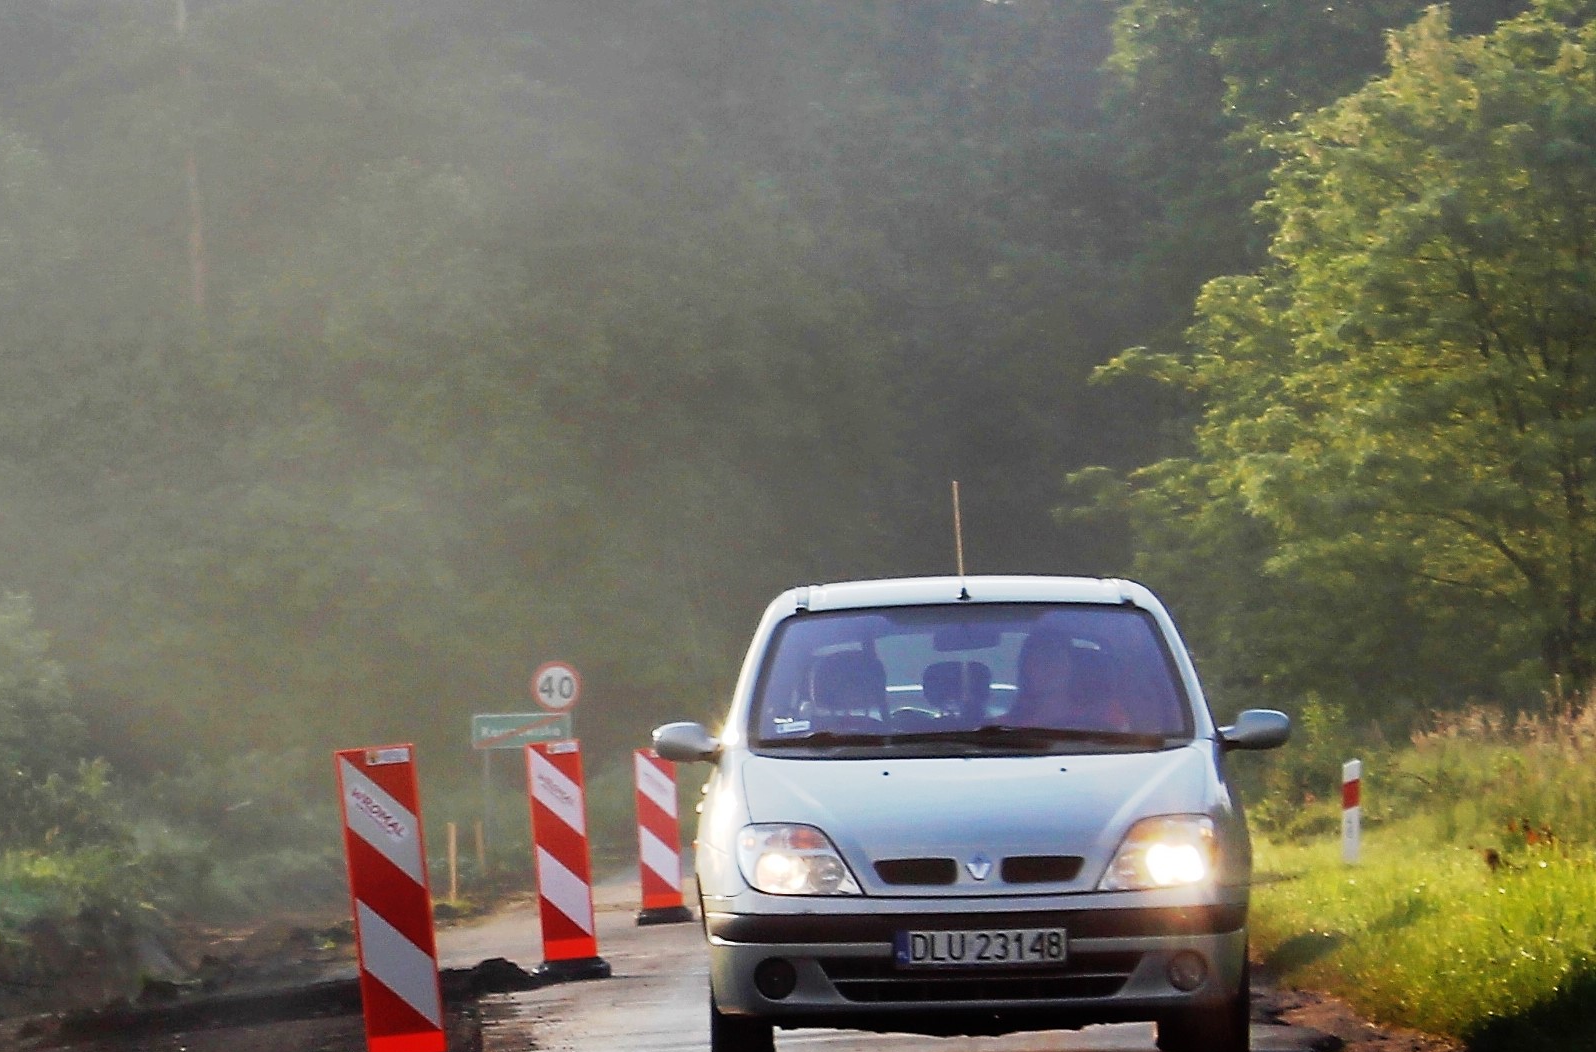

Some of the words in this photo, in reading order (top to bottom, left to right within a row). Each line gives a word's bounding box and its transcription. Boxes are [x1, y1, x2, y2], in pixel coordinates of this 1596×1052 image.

[539, 675, 574, 699] 40
[911, 933, 966, 961] DLU
[977, 931, 1062, 961] 23148
